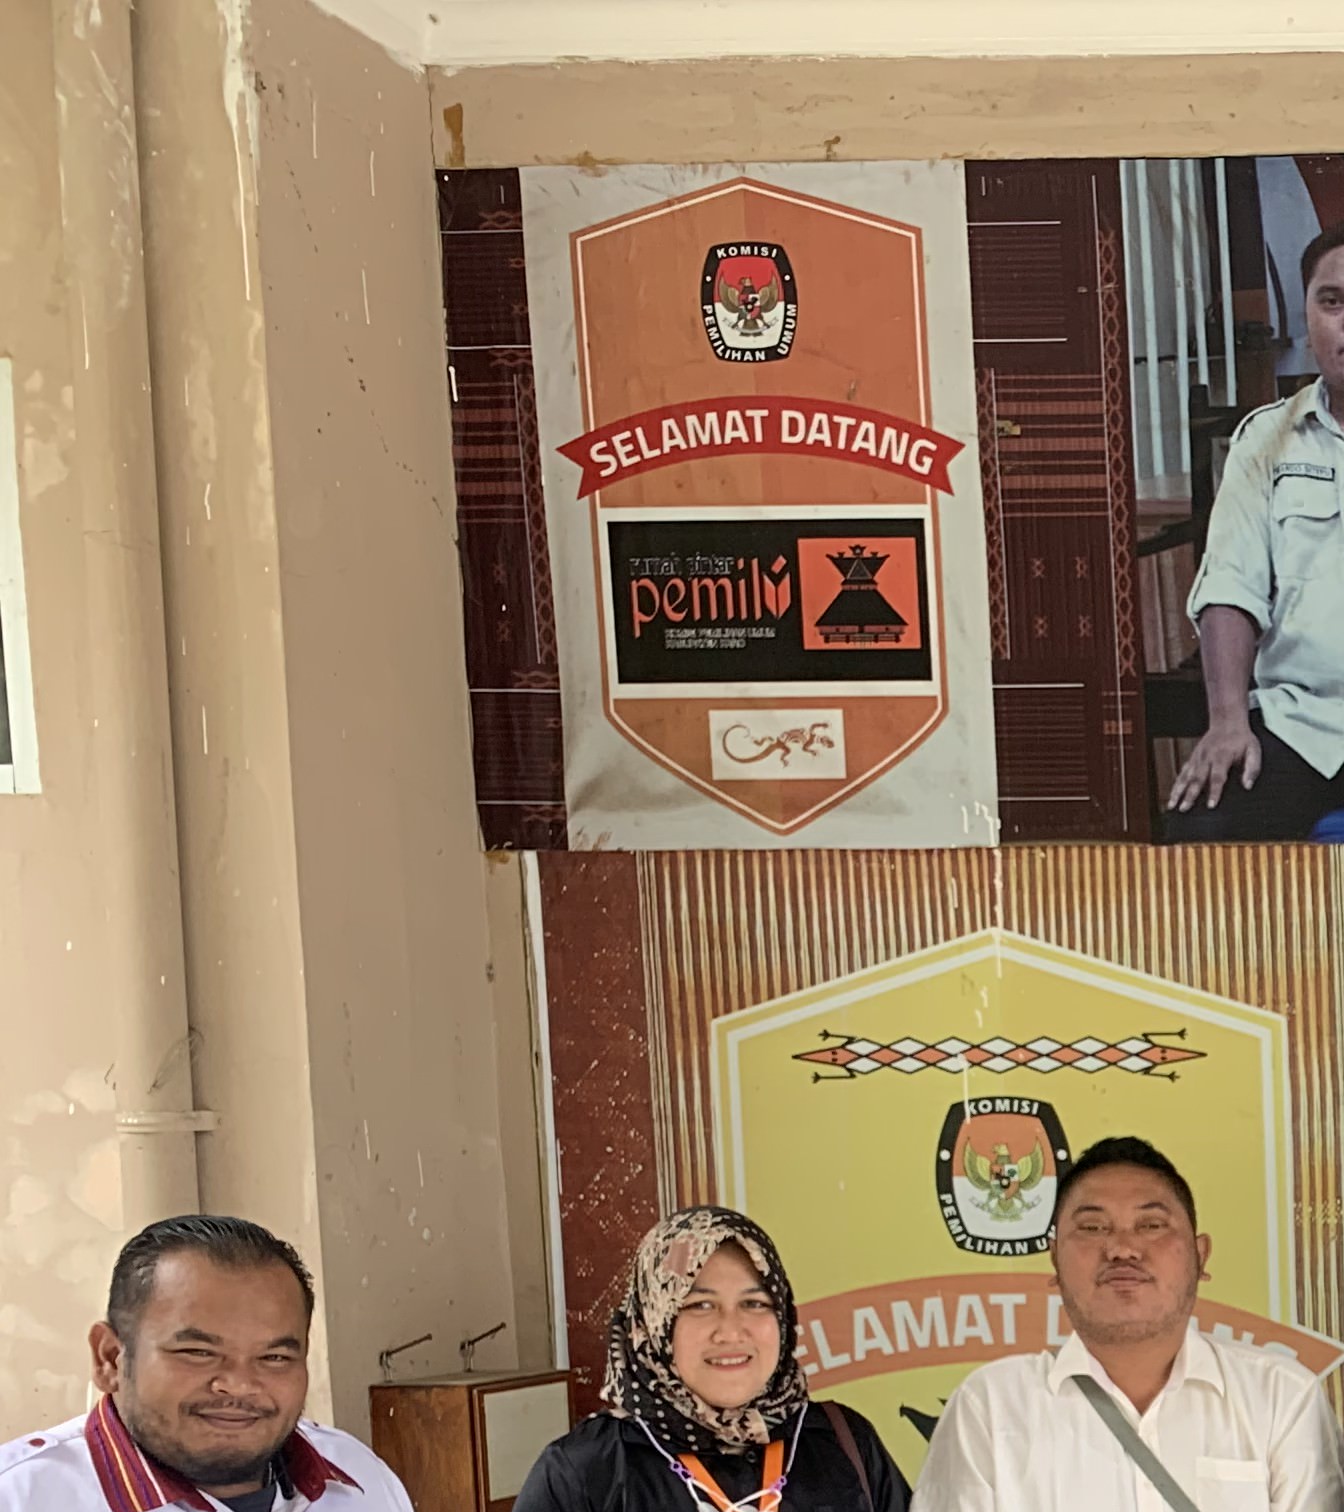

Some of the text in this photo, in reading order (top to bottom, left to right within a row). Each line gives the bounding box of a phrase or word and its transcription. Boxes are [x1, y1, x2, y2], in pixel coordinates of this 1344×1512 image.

[716, 246, 778, 259] KOMISI
[703, 303, 797, 361] PEMILIHAN UMUM
[589, 409, 937, 477] SELAMAT DATANG
[631, 555, 792, 639] pemilu
[967, 1098, 1040, 1115] KOMISI
[940, 1193, 1028, 1255] PEMILIHAN
[793, 1293, 1027, 1376] ELAMAT
